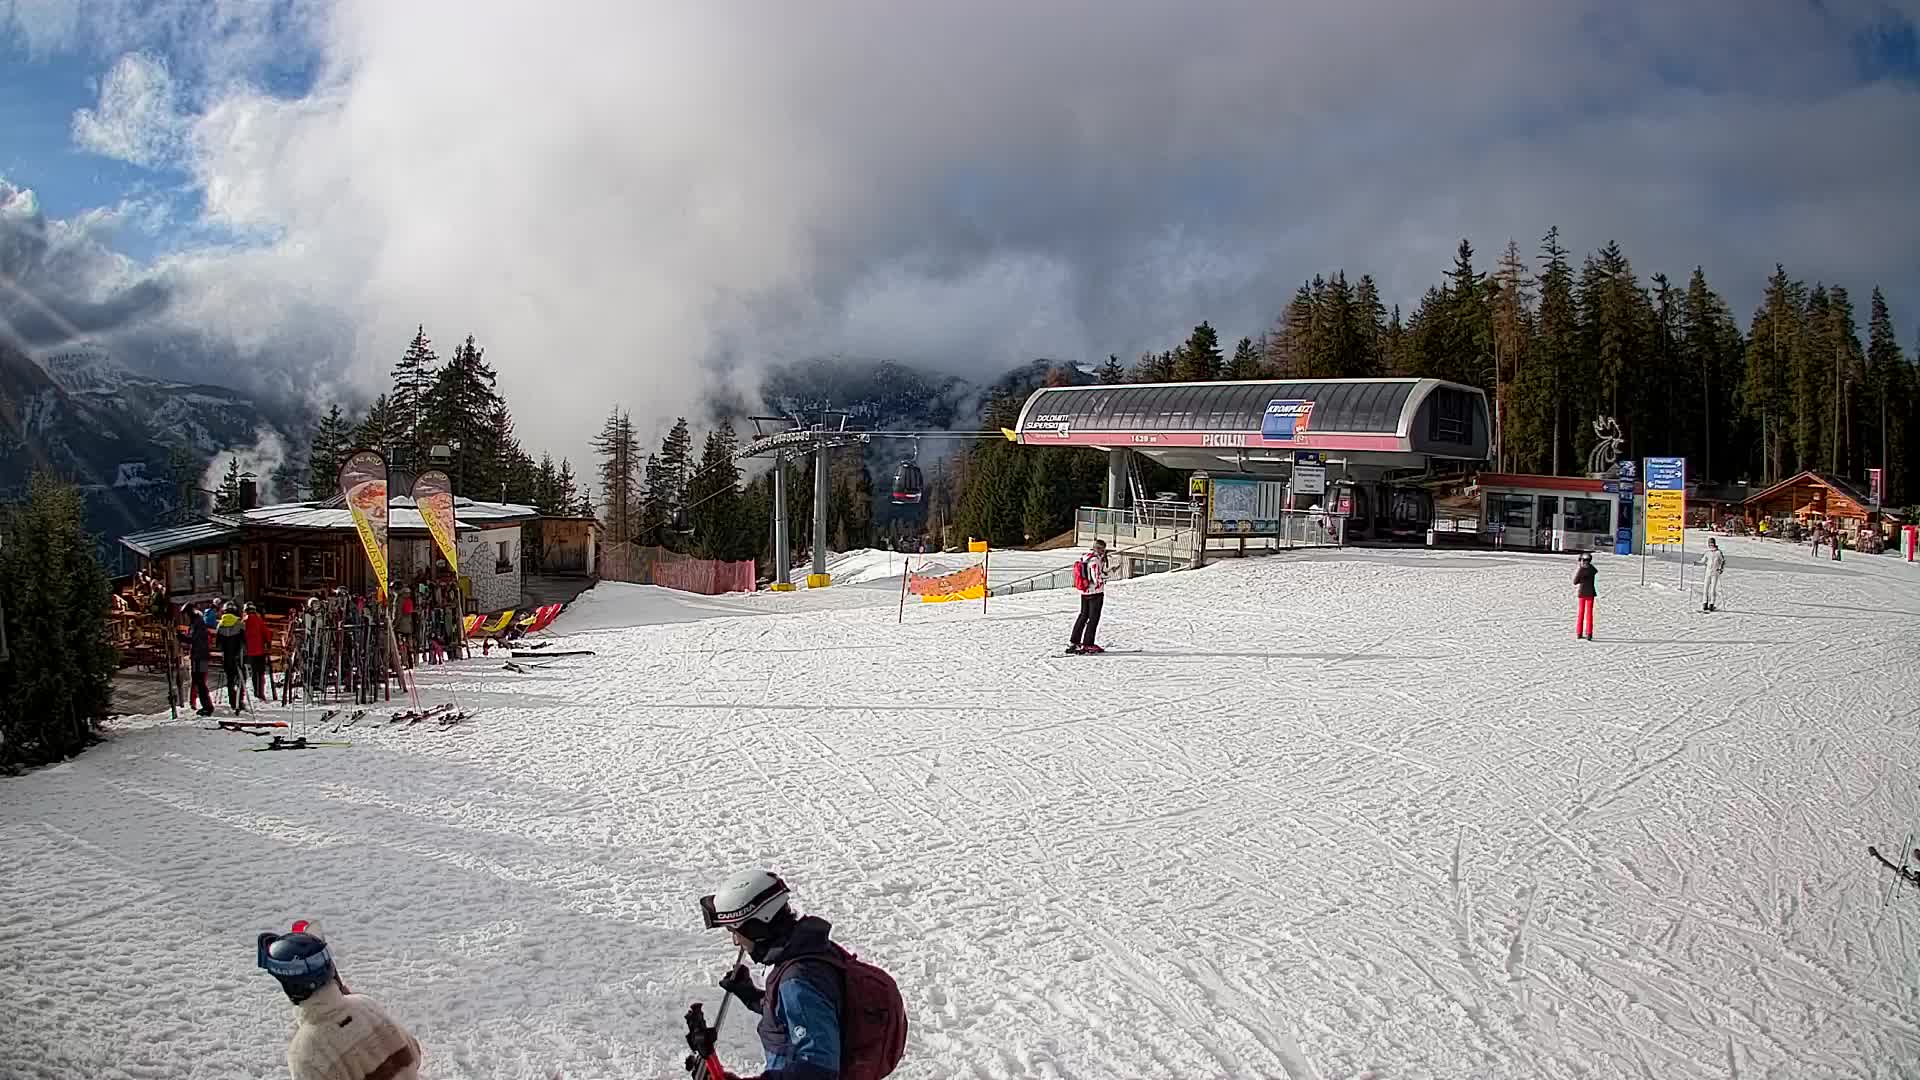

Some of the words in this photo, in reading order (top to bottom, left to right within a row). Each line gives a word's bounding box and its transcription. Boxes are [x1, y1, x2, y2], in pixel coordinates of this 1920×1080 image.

[1036, 414, 1069, 422] DOLOMITI
[1025, 422, 1059, 430] SUPERSKI
[1203, 434, 1246, 447] PICULIN
[717, 904, 755, 919] CARRERA
